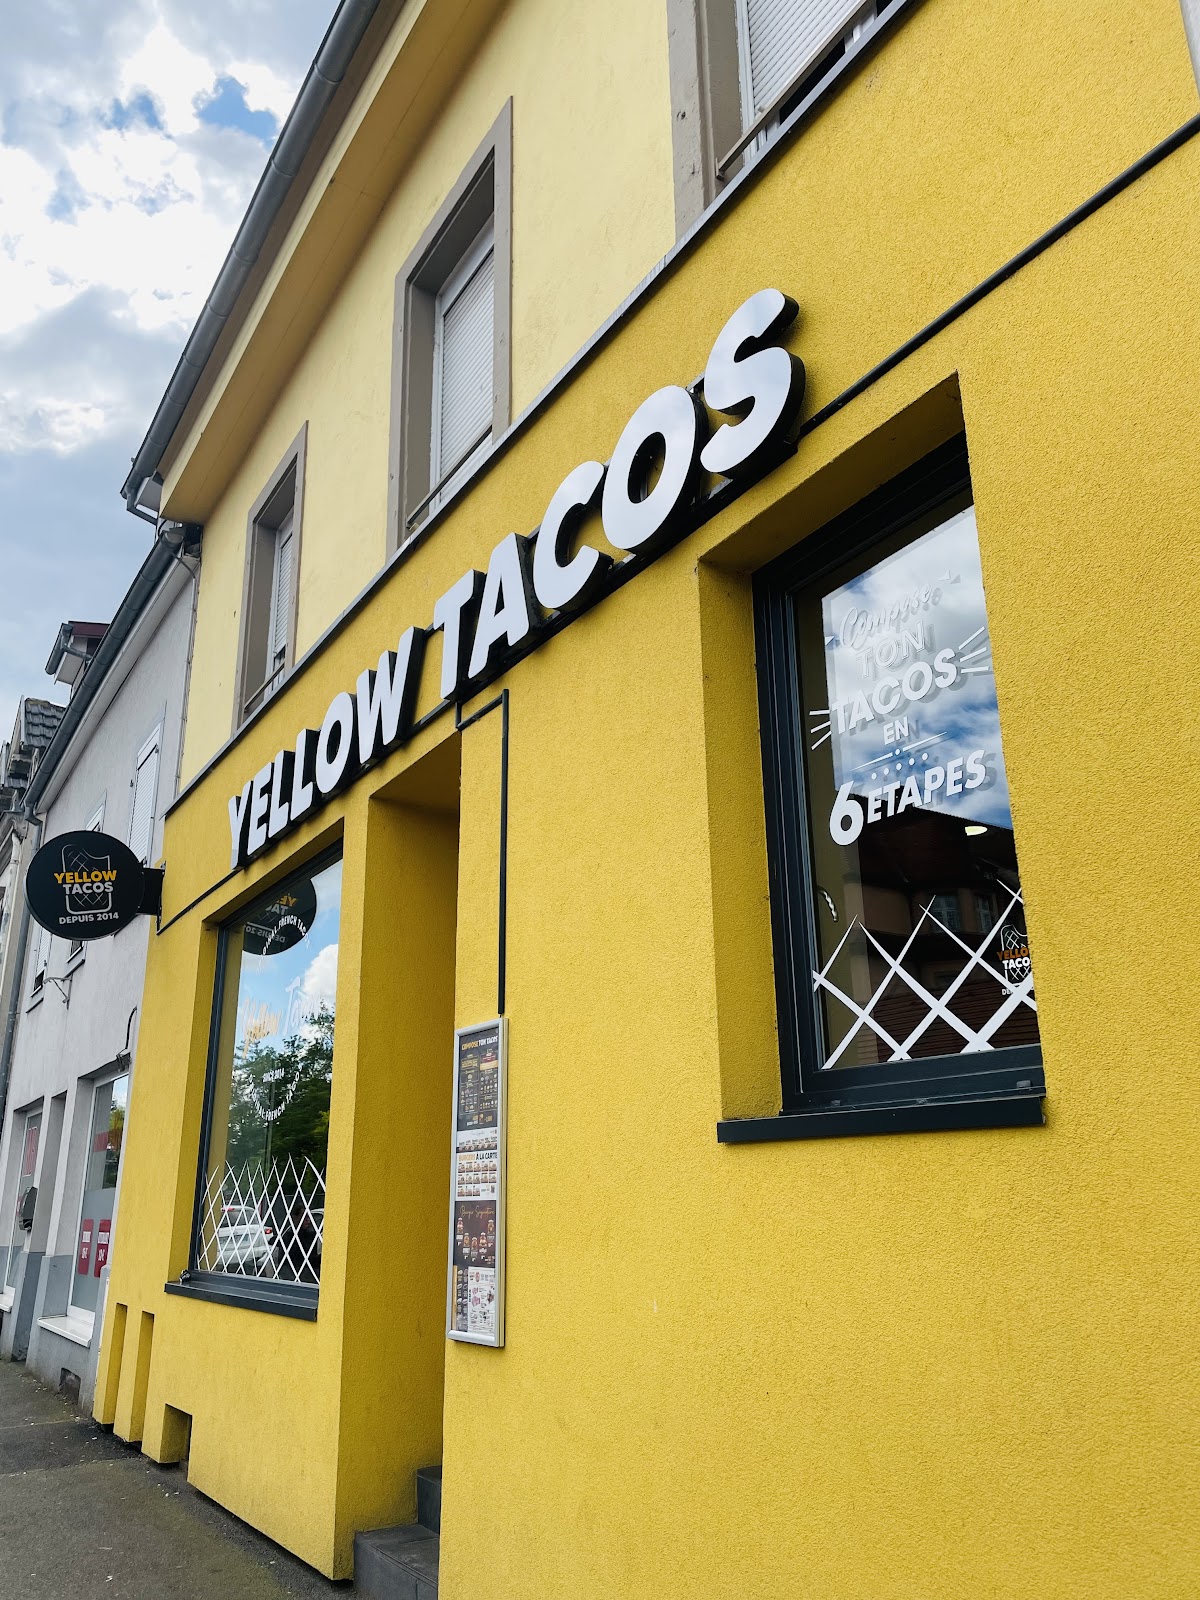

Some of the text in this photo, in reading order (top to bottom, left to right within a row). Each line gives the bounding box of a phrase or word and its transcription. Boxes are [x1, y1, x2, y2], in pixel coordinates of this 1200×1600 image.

[228, 288, 796, 870] YELLOW TACOS
[840, 583, 932, 648] Compose
[855, 620, 925, 679] TON
[831, 648, 957, 734] TACOS
[883, 716, 910, 745] EN
[829, 749, 986, 846] 6 ETAPES
[54, 870, 117, 884] YELLOW
[62, 881, 114, 895] TACOS
[58, 912, 119, 925] DEPUIS 2014
[996, 947, 1030, 961] YELLO
[1002, 956, 1032, 970] TACO
